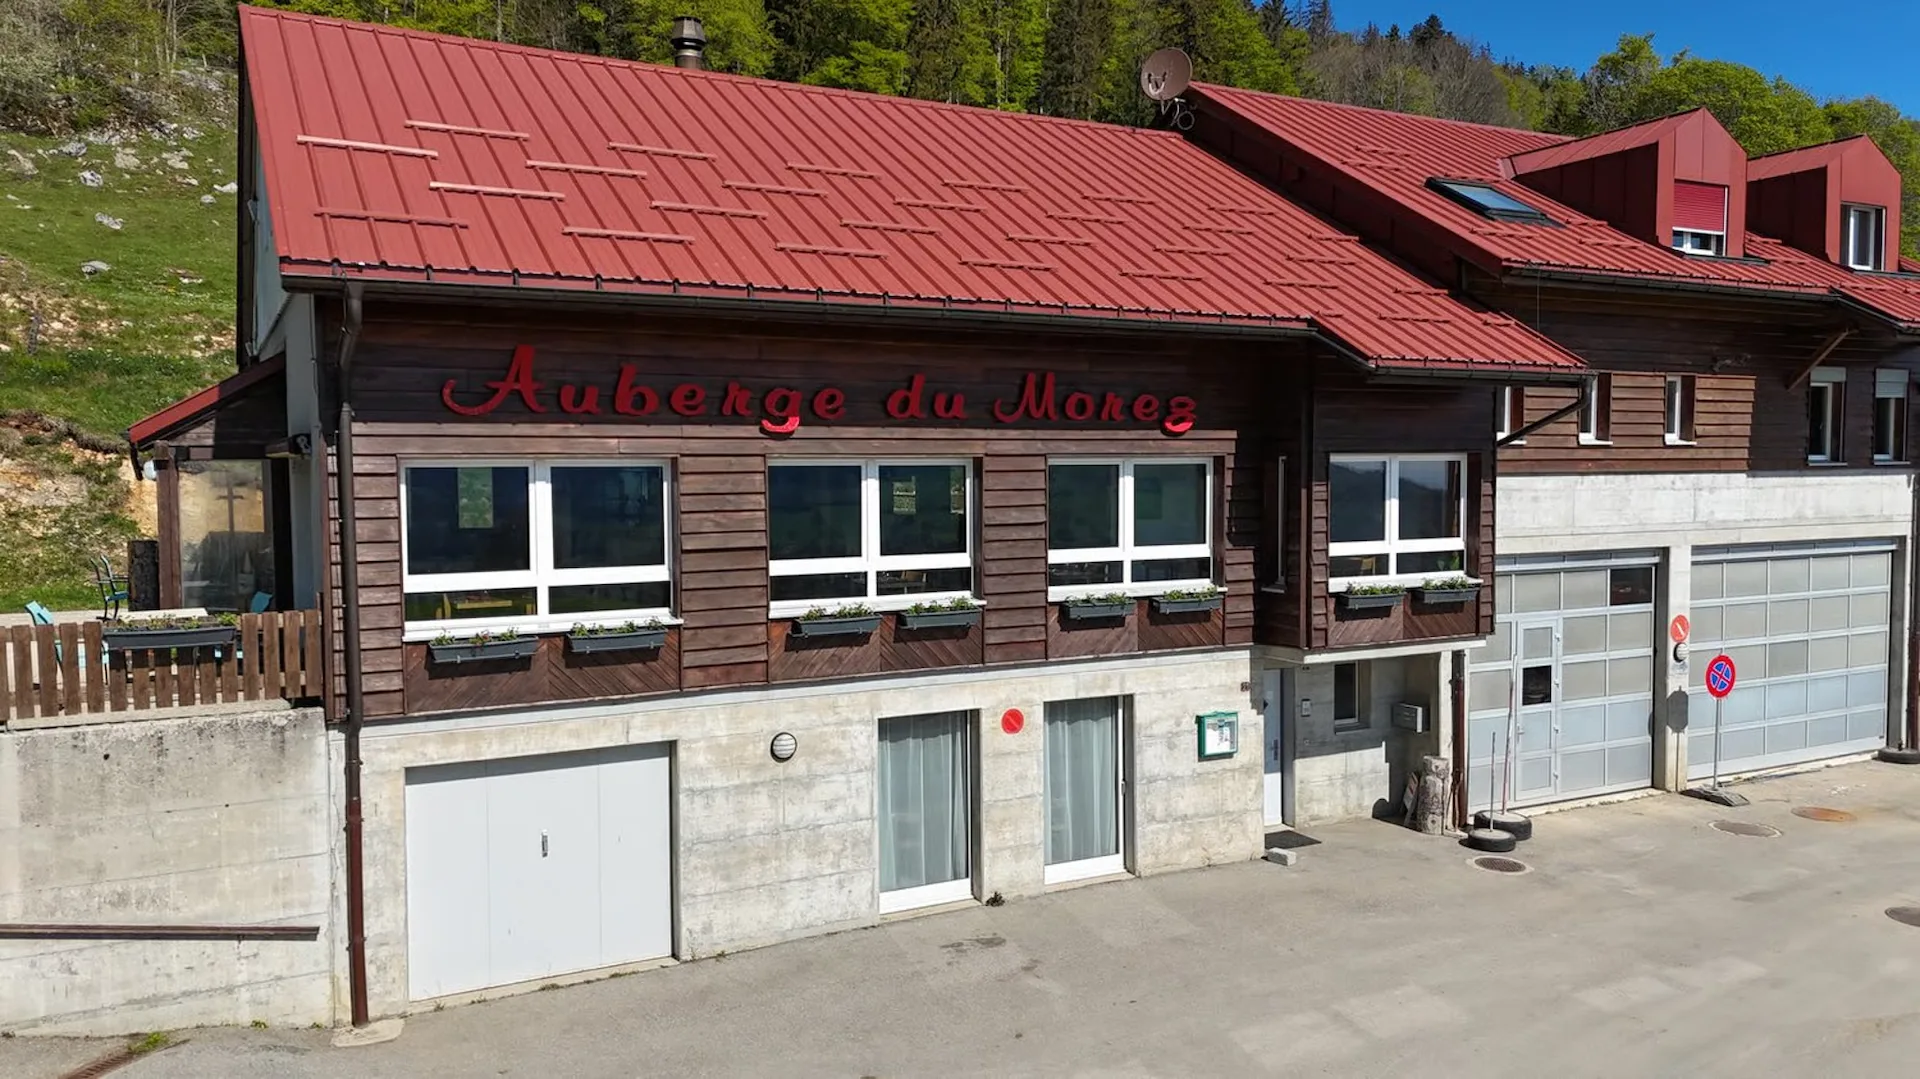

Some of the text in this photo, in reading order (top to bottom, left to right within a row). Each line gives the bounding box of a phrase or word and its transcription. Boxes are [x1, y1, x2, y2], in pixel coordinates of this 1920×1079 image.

[441, 343, 1197, 433] Auberge du Morez
